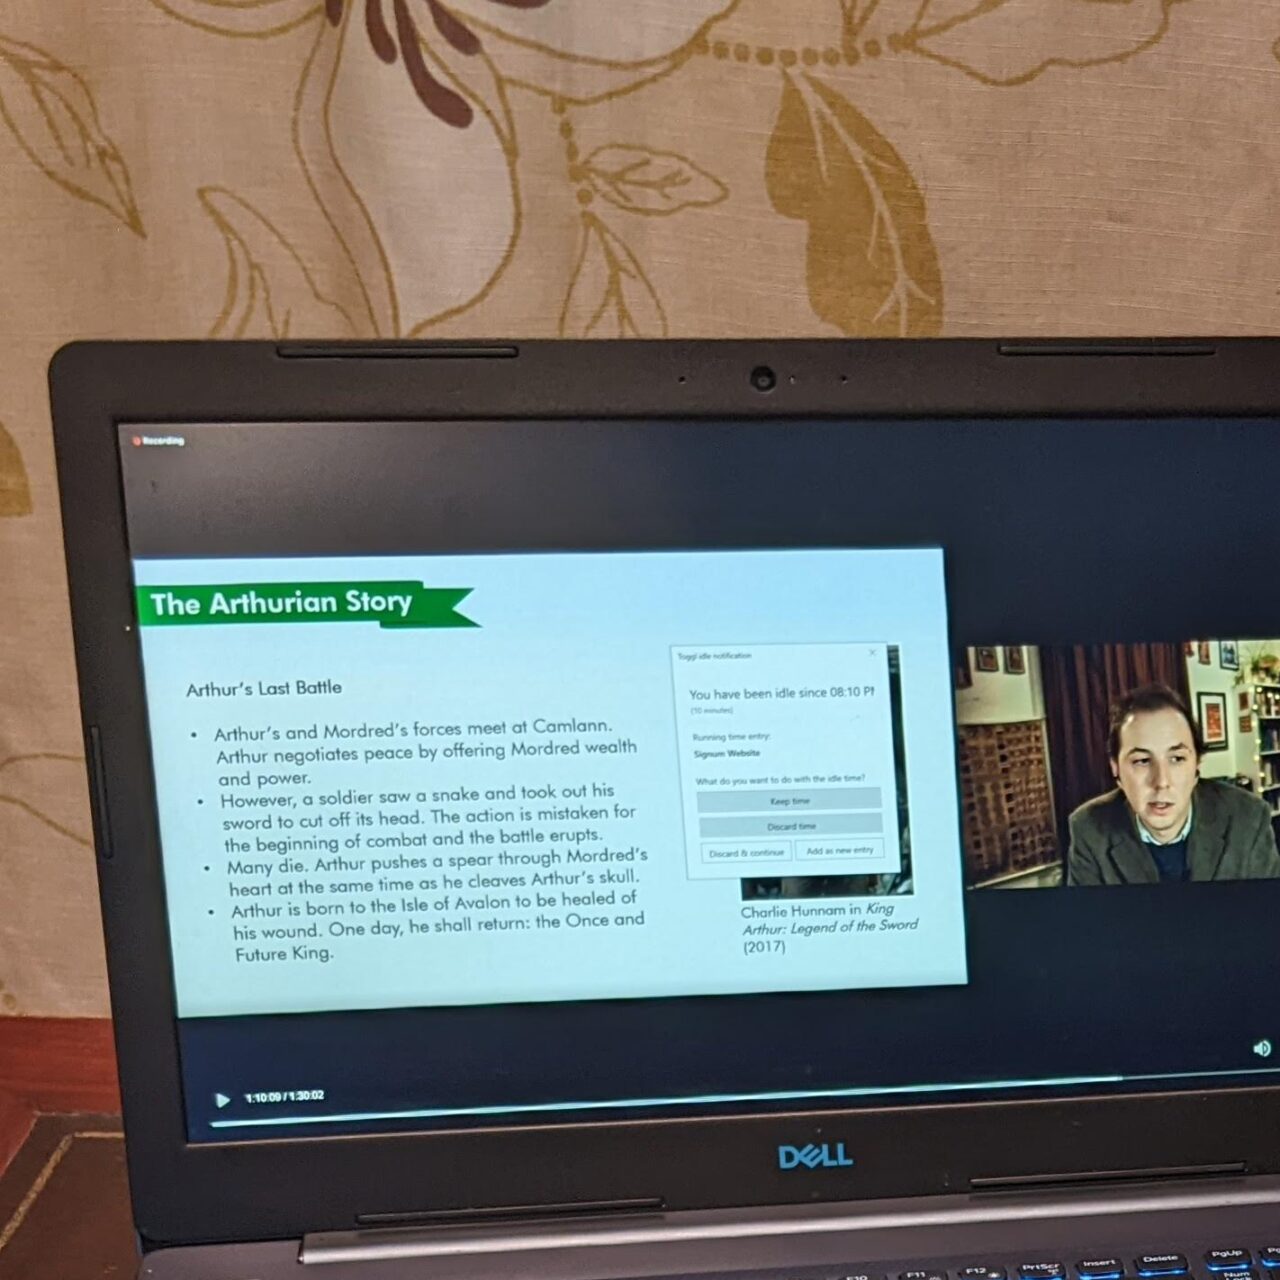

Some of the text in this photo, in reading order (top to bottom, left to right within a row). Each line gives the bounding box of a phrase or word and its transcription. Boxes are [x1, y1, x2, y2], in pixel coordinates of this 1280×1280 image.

[143, 435, 185, 447] Recording
[150, 590, 412, 616] The Arthurian Story
[187, 679, 342, 696] Arthur's Last Battle
[689, 689, 711, 701] You
[713, 689, 741, 700] have
[743, 688, 773, 700] been
[776, 688, 797, 699] idle
[798, 687, 827, 699] since
[830, 686, 861, 698] 08:10
[214, 718, 612, 741] Arthur's and Mordred's forces meet at Camlann.
[217, 739, 636, 766] Arthur negotiates peace by offering Mordred wealth
[219, 771, 311, 789] and power.
[221, 783, 614, 808] However, a soldier saw a snake and took out his
[771, 798, 790, 806] Keep
[223, 804, 635, 830] sword to cut off its head. The action is mistaken for
[225, 828, 602, 855] the beginning of combat and the battle erupts.
[741, 902, 894, 918] Charlie Hunnam in King
[743, 918, 919, 936] Arthur: Legend of the Sword
[744, 940, 785, 955] (2017)
[778, 1143, 854, 1170] DELL
[1142, 1254, 1179, 1263] Delete
